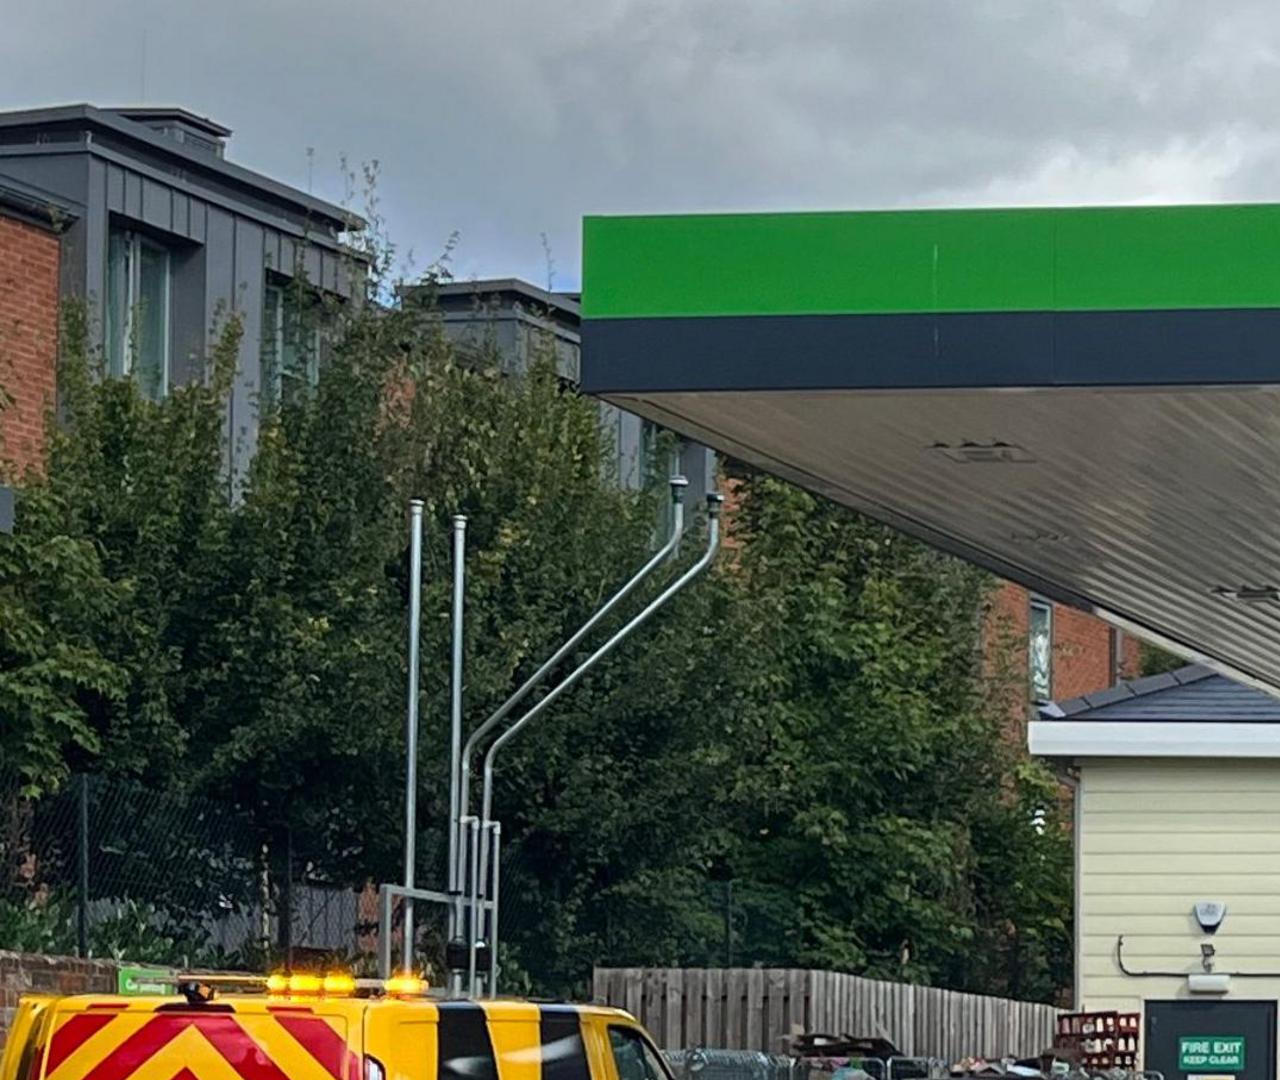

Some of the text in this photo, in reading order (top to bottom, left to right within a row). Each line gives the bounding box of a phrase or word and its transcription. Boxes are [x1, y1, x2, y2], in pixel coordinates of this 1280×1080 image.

[1182, 1041, 1242, 1053] FIRE EXIT
[1183, 1055, 1239, 1065] KEEP CLEAR
